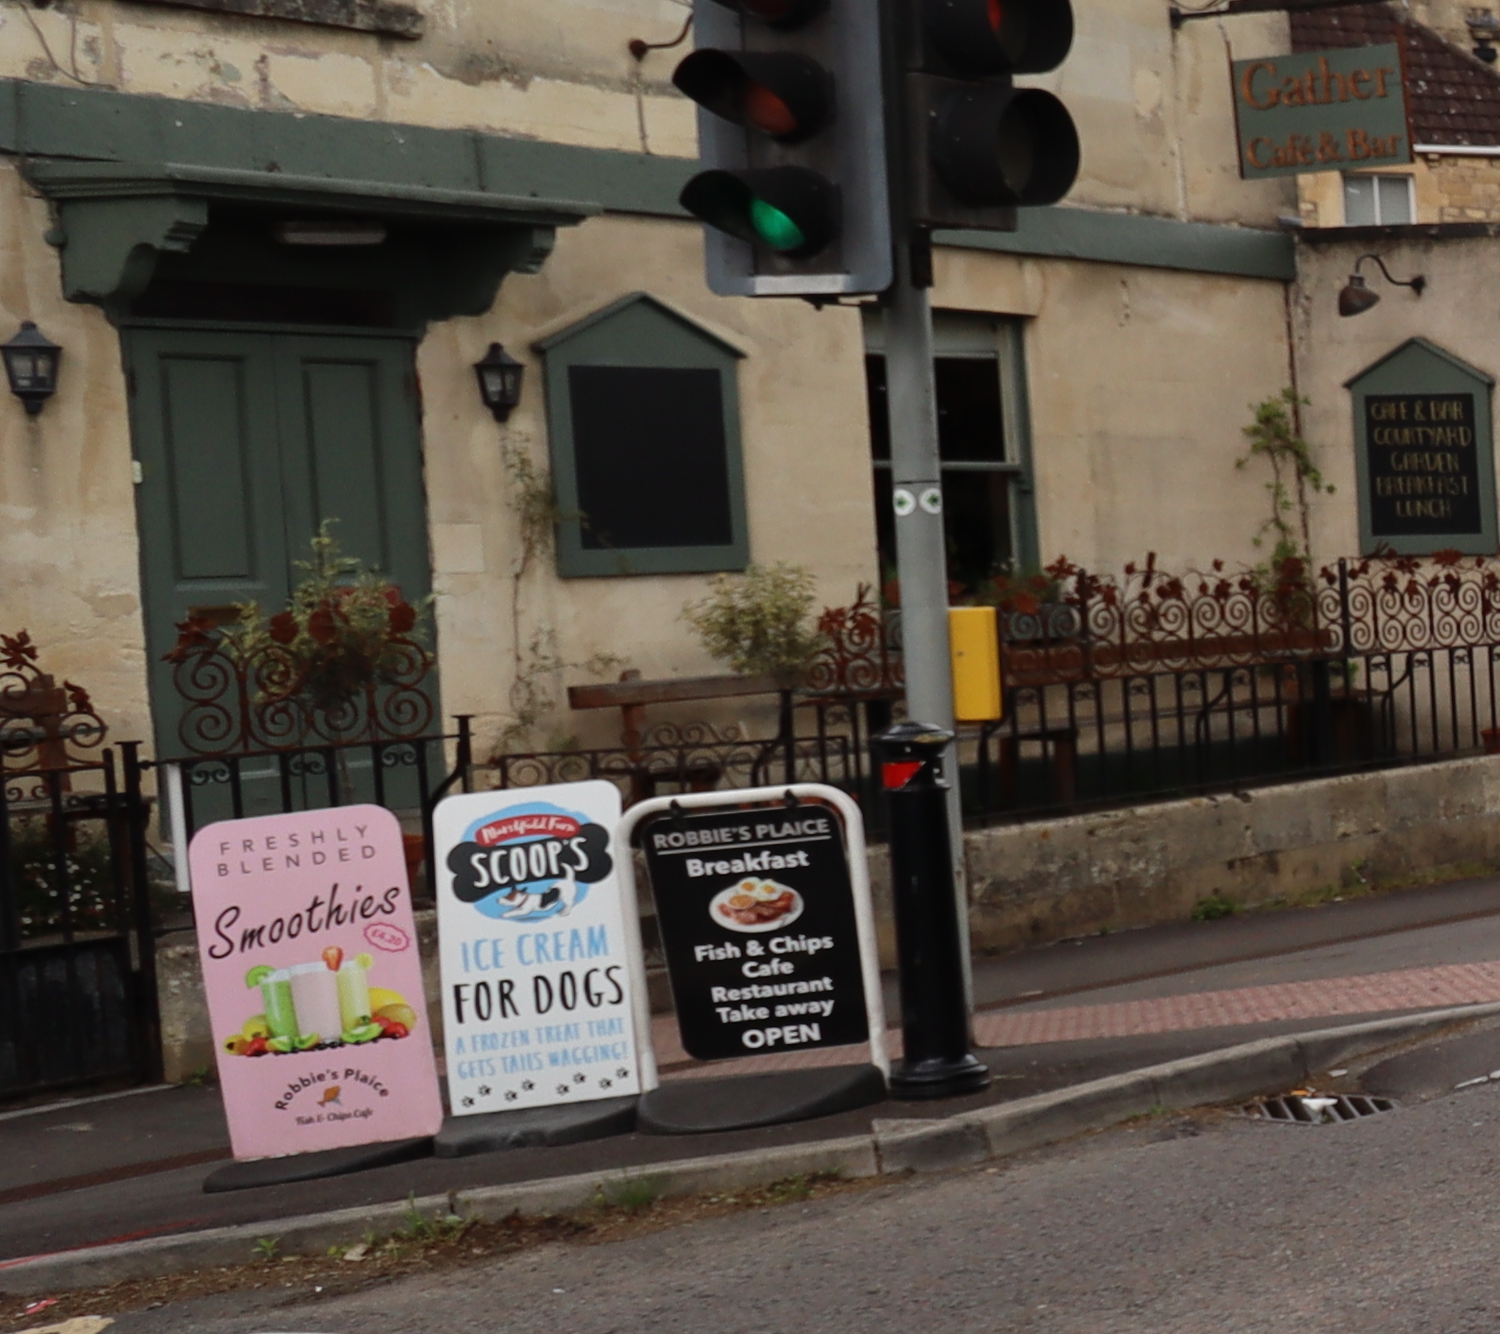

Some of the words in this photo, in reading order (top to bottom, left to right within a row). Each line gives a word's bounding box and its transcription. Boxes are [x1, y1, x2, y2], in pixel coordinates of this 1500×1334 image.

[1240, 56, 1394, 110] Gather
[1246, 131, 1315, 169] Café
[1316, 130, 1344, 163] &
[1345, 128, 1402, 161] Bar
[1395, 498, 1452, 518] LUNCH
[219, 825, 369, 855] FRESHLY
[653, 826, 752, 849] ROBBIE'S
[755, 818, 831, 840] PLAICE
[217, 845, 376, 877] BLENDED
[470, 836, 589, 888] SCOOP'S
[685, 850, 810, 878] Breakfast
[208, 882, 400, 960] Smoothies
[461, 938, 506, 973] ICE
[516, 924, 610, 966] CREAM
[694, 942, 742, 963] Fish
[746, 940, 766, 957] &
[769, 934, 834, 956] Chips
[741, 958, 794, 979] Cafe
[453, 978, 521, 1024] FOR
[533, 965, 624, 1015] DOGS
[711, 976, 834, 1003] Restaurant
[715, 1004, 770, 1024] Take
[774, 999, 835, 1017] away
[455, 1036, 466, 1055] A
[471, 1029, 531, 1053] FROZEN
[535, 1022, 581, 1046] TREAT
[586, 1017, 625, 1038] THAT
[741, 1023, 822, 1049] OPEN
[457, 1059, 497, 1080] GETS
[501, 1052, 544, 1075] TAILS
[547, 1041, 629, 1067] WAGGING!
[274, 1069, 339, 1111] Robbie's
[343, 1068, 389, 1098] Plaice
